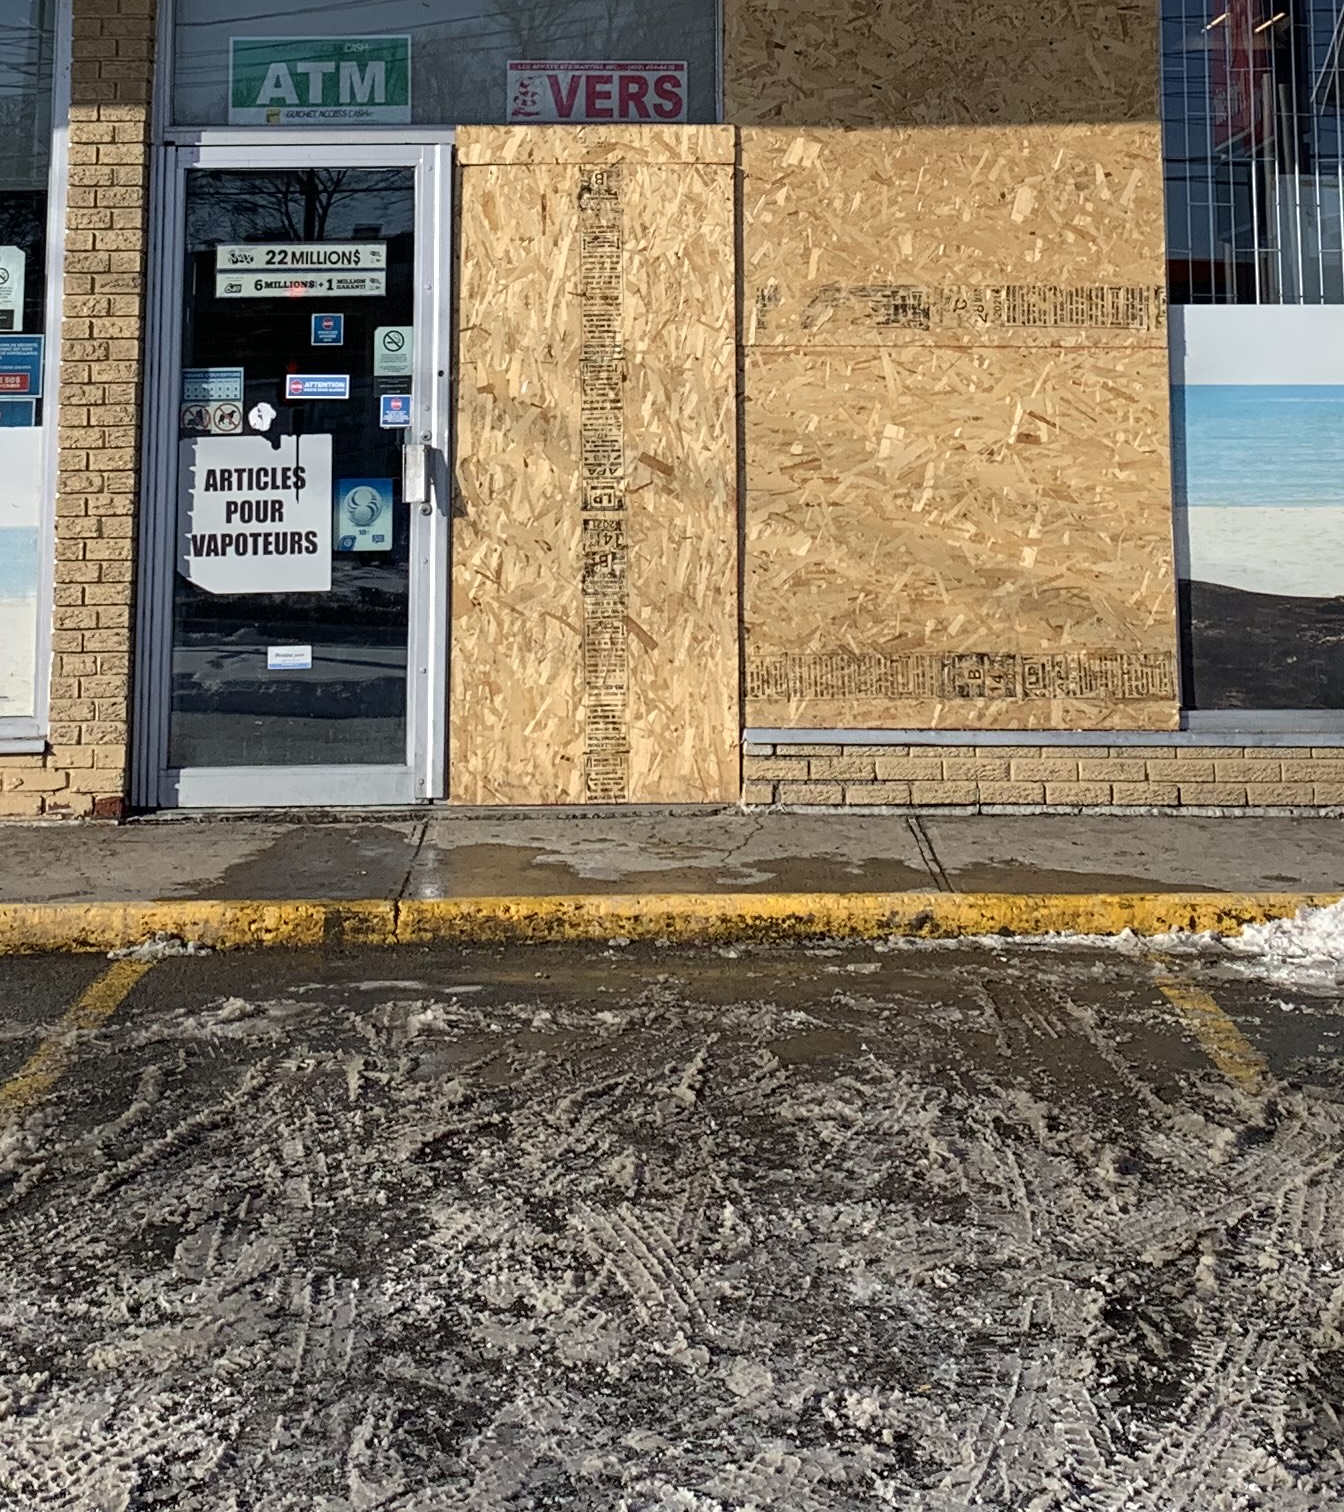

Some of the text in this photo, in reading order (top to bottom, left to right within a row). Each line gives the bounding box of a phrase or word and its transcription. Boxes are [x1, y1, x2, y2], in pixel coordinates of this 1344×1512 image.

[256, 60, 386, 105] ATM
[546, 74, 684, 120] VERS
[285, 109, 317, 119] GUICHET
[318, 109, 348, 119] ACCESS
[265, 249, 289, 265] 22
[291, 248, 361, 267] MILLION$
[254, 279, 264, 291] 6
[326, 278, 334, 291] 1
[204, 466, 307, 492] ARTICLES
[225, 499, 284, 524] POUR
[190, 530, 318, 558] VAPOTEURS
